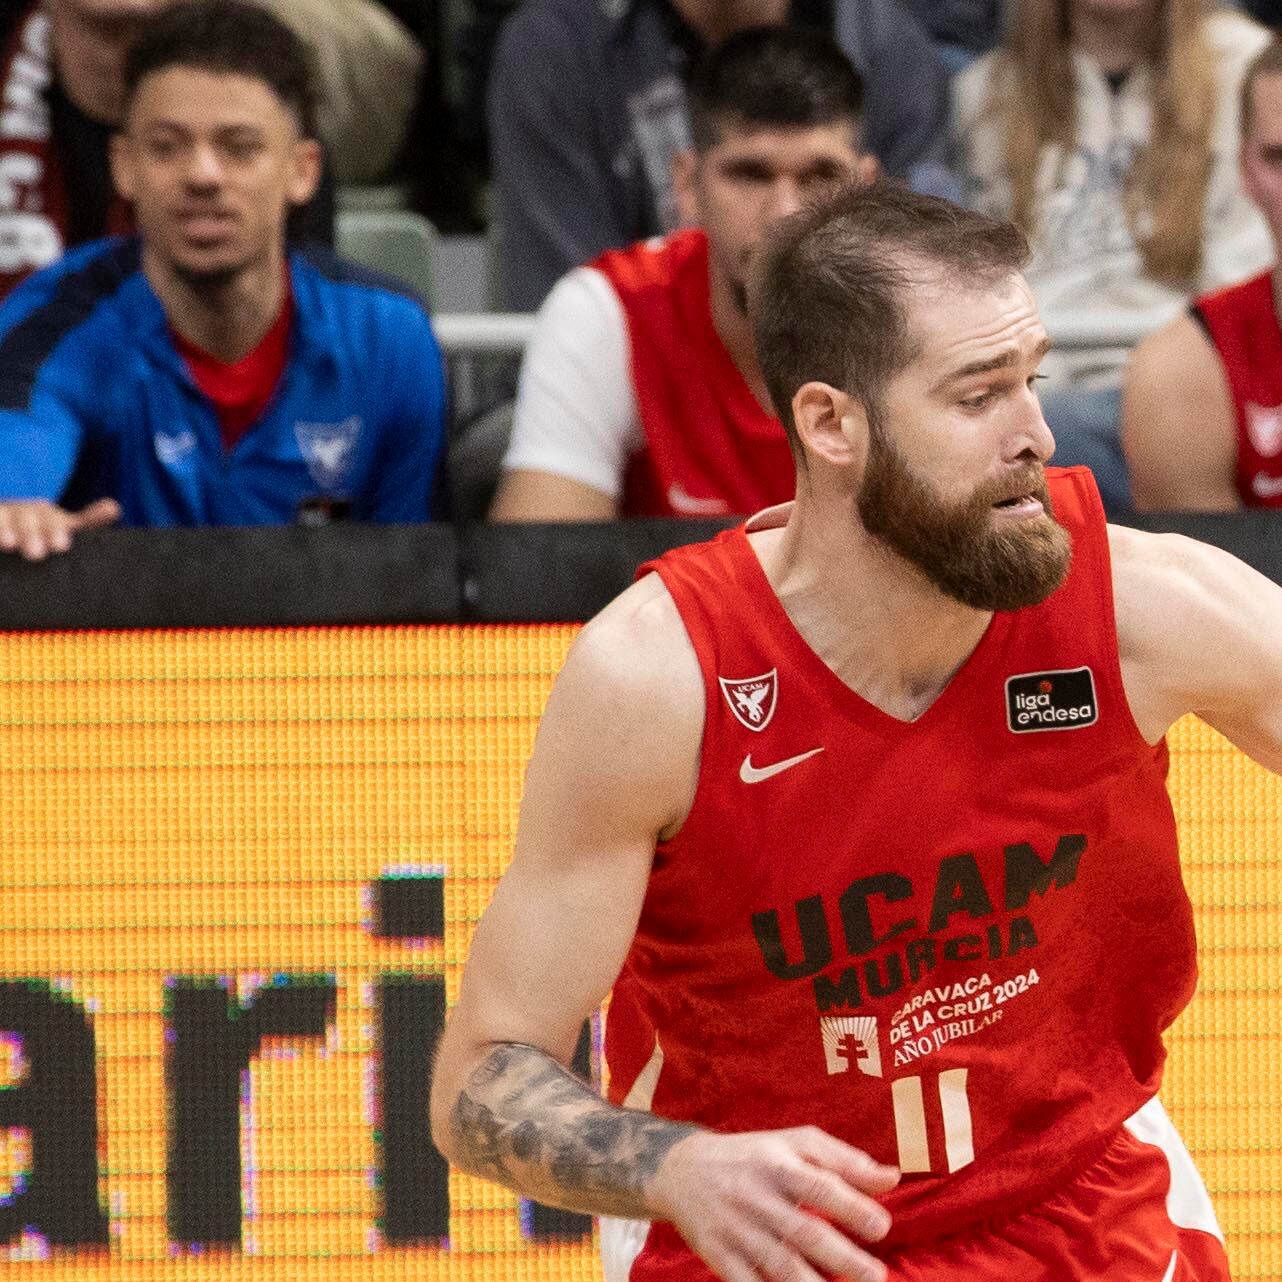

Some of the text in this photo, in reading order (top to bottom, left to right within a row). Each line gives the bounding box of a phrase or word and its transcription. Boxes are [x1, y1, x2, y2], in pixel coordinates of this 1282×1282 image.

[1016, 693, 1050, 710] liga
[1018, 705, 1091, 724] endesa
[753, 834, 1087, 981] UCAM
[812, 916, 1038, 1012] MURCIA
[890, 968, 1040, 1045] DE LA CRUZ 2024
[891, 973, 991, 1026] CARAVACA
[894, 1009, 1003, 1067] AÑO JUBILAR
[891, 1068, 975, 1174] 11
